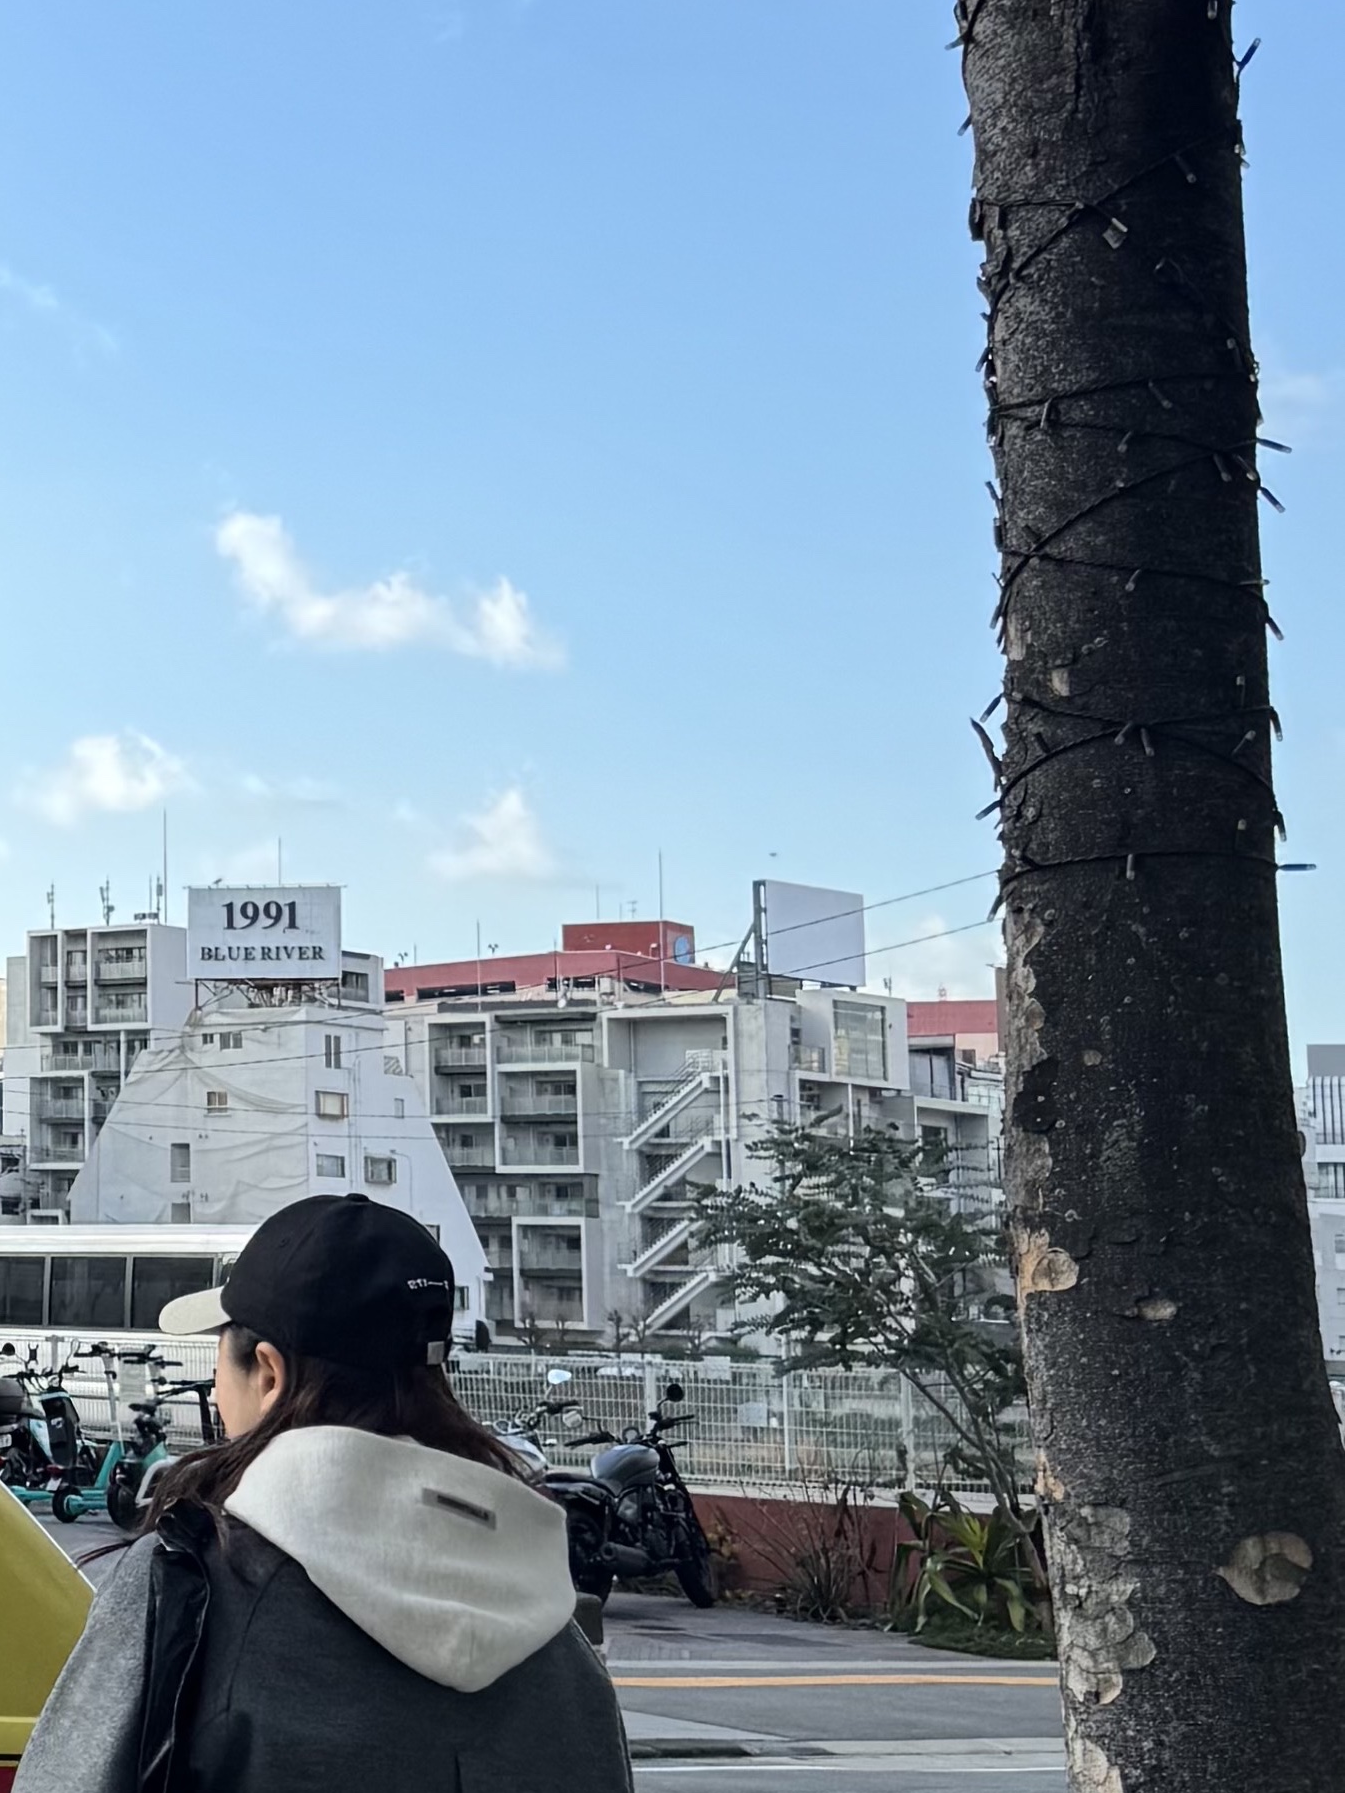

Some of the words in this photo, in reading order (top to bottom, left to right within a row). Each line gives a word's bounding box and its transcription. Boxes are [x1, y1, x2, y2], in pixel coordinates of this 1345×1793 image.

[222, 900, 300, 931] 1991
[200, 946, 256, 961] BLUE
[261, 946, 326, 961] RIVER
